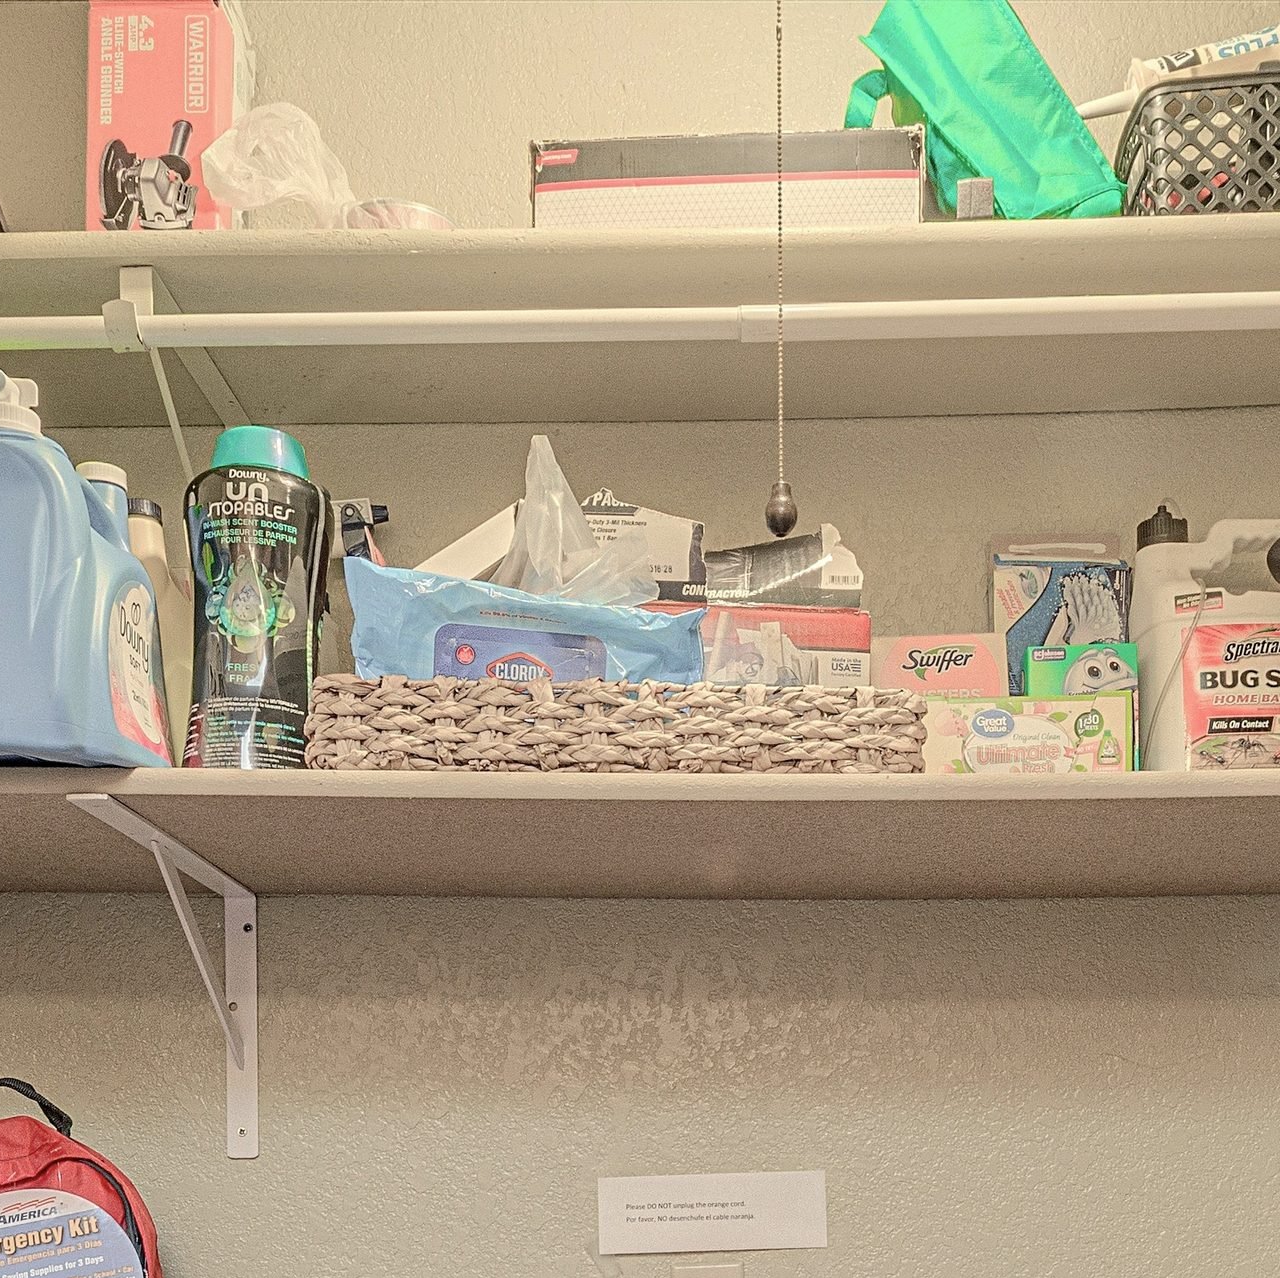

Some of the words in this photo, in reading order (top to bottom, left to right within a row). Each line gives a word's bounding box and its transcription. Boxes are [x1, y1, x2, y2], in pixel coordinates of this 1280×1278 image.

[101, 17, 113, 62] ANGLE
[139, 15, 154, 51] 4.3
[114, 16, 124, 94] SLIDE-SWITCH
[188, 21, 204, 108] WARRIOR
[100, 65, 113, 125] GRINDER
[229, 469, 269, 482] Downy
[207, 501, 295, 521] STOPABLES
[203, 518, 230, 530] IN-WASH
[232, 519, 258, 527] SCENT
[260, 520, 297, 534] BOOSTER
[204, 528, 250, 540] REHAUSSEUR
[252, 529, 264, 537] DE
[265, 532, 297, 545] PARFUM
[220, 536, 241, 544] POUR
[243, 537, 277, 547] LESSIVE
[120, 606, 148, 673] Downy
[832, 663, 851, 672] USA
[902, 649, 973, 673] Swiffer
[1200, 670, 1259, 690] BUG
[1214, 694, 1258, 704] HOME
[976, 716, 1008, 727] Great
[983, 724, 1008, 733] Value
[1212, 721, 1228, 730] Kills
[1229, 720, 1240, 729] On
[1241, 719, 1269, 729] Contact
[976, 742, 1060, 764] Ultimate
[673, 1203, 695, 1211] unplug
[707, 1202, 730, 1210] orange
[731, 1200, 746, 1208] cord.
[68, 1216, 99, 1238] Kit
[669, 1214, 704, 1222] desenchufe
[731, 1213, 755, 1221] naranja.
[30, 1264, 63, 1278] Supplies
[65, 1261, 76, 1269] for
[85, 1255, 105, 1266] Days
